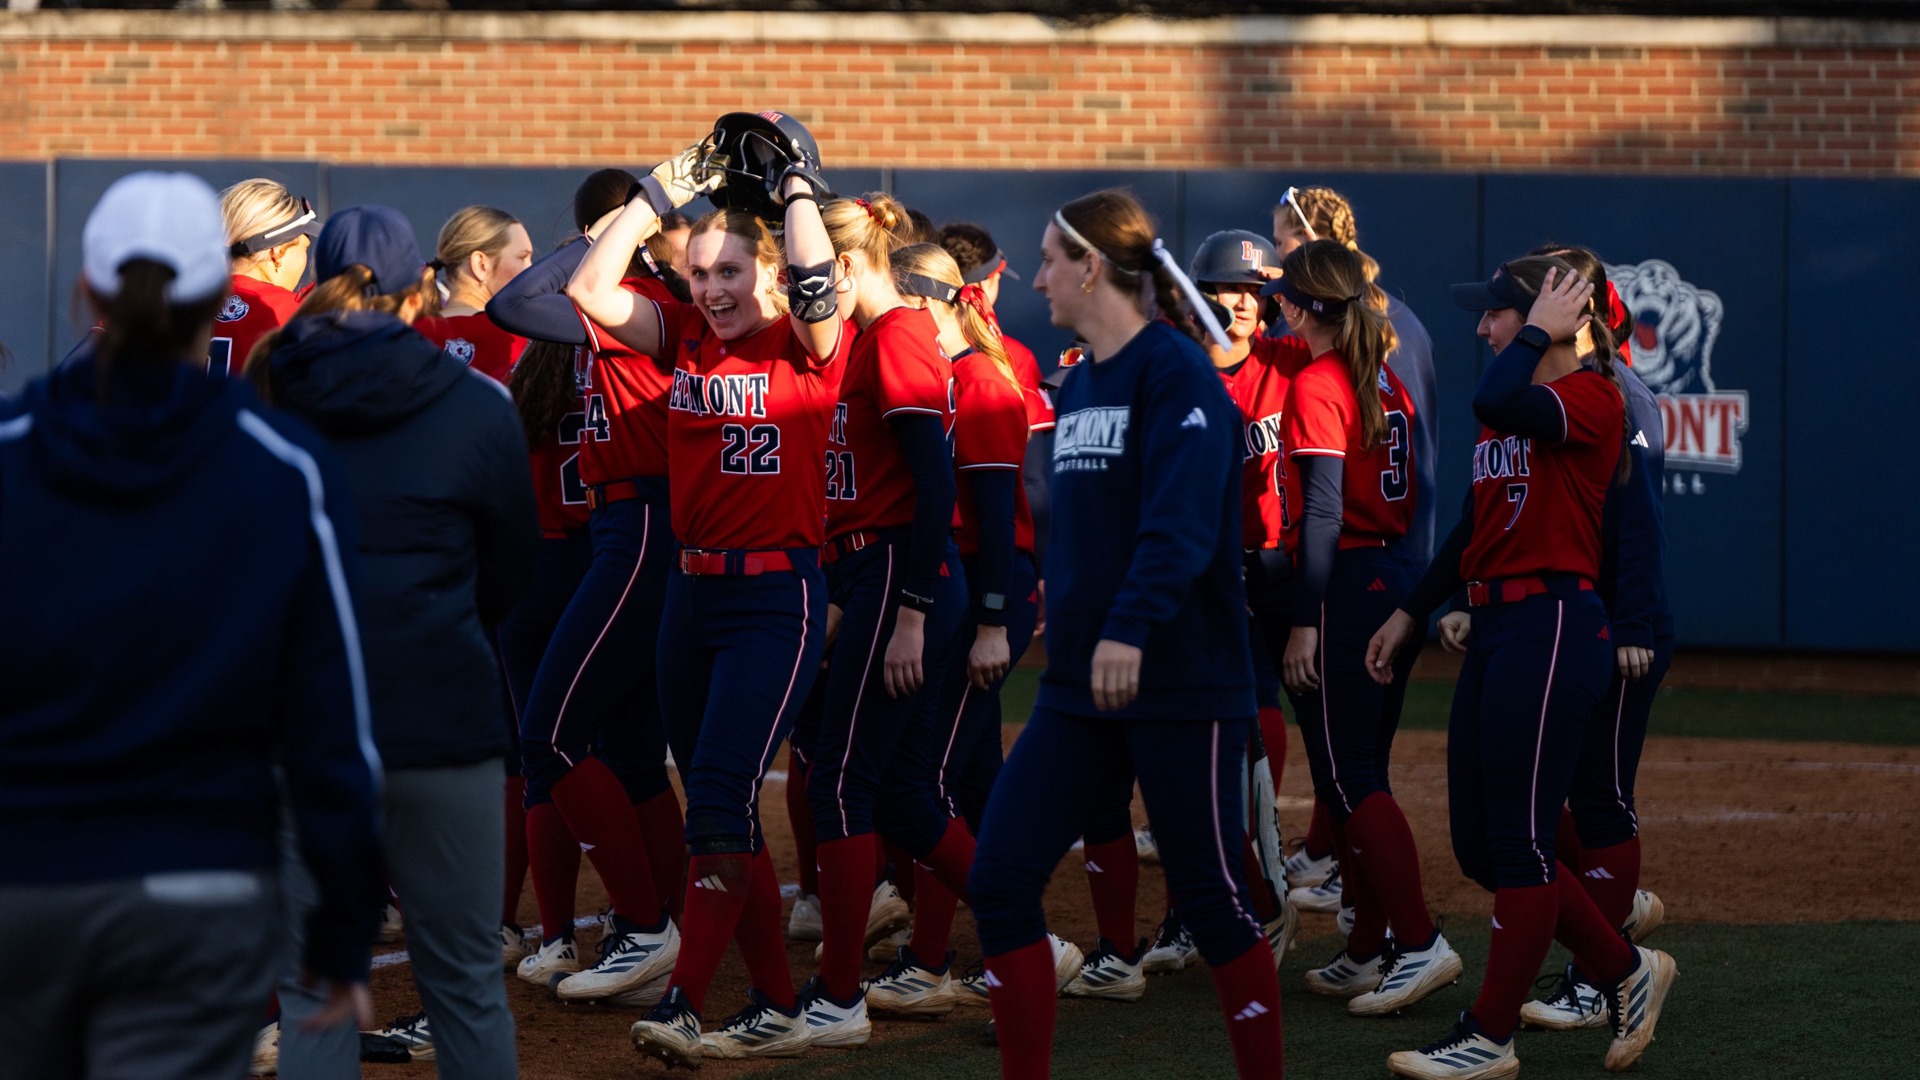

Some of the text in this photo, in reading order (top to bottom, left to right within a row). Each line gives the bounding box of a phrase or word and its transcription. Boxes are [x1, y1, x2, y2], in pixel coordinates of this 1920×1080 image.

[669, 367, 769, 418] ELMONT
[584, 393, 610, 444] 4
[1657, 394, 1742, 461] ONT
[721, 423, 780, 475] 22
[1055, 457, 1108, 474] SOFTBALL
[1380, 409, 1409, 502] 3
[1473, 435, 1531, 484] MONT
[825, 450, 857, 500] 21
[1663, 472, 1705, 495] LL
[1504, 483, 1528, 531] 7
